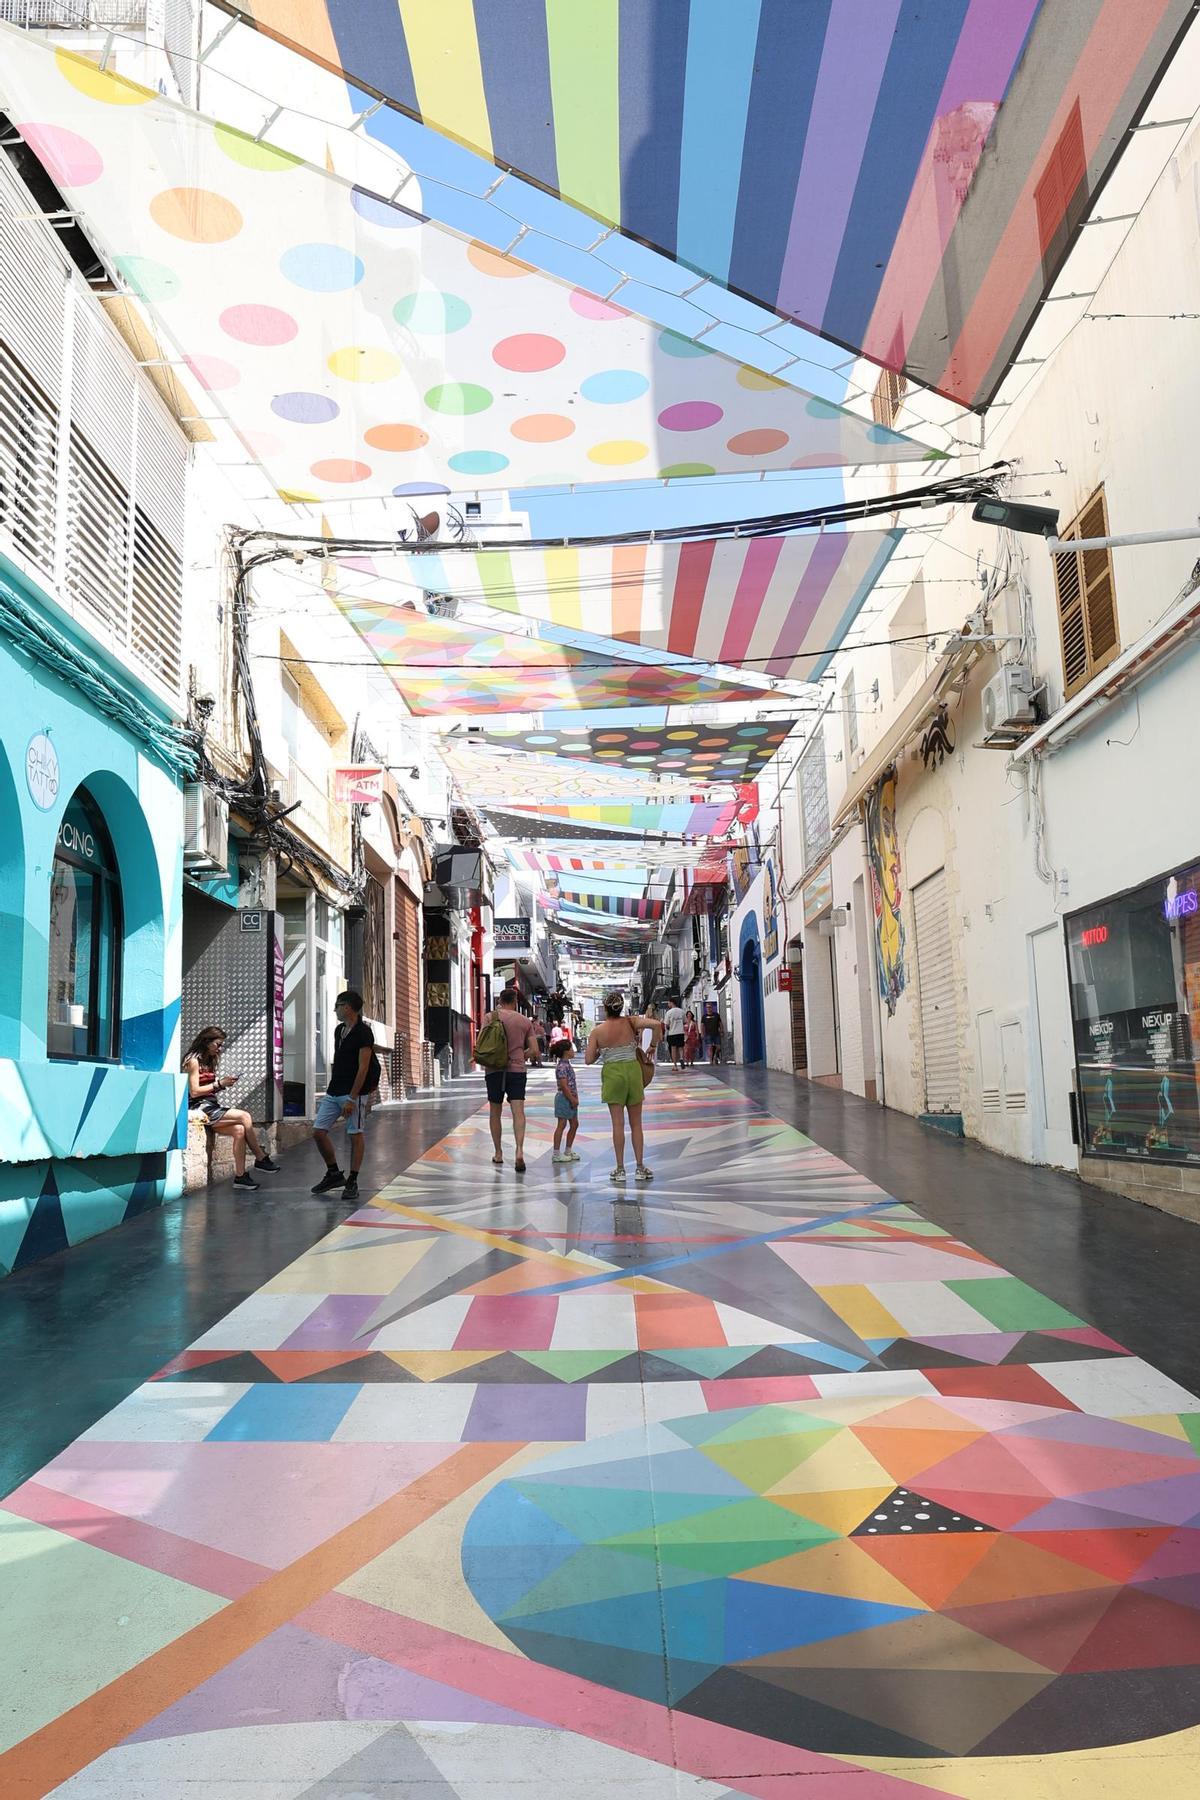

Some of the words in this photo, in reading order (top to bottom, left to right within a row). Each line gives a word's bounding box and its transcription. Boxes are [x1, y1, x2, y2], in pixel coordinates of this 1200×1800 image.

[356, 781, 380, 790] ATM
[243, 914, 259, 925] CC
[1141, 1013, 1173, 1029] NEXUP
